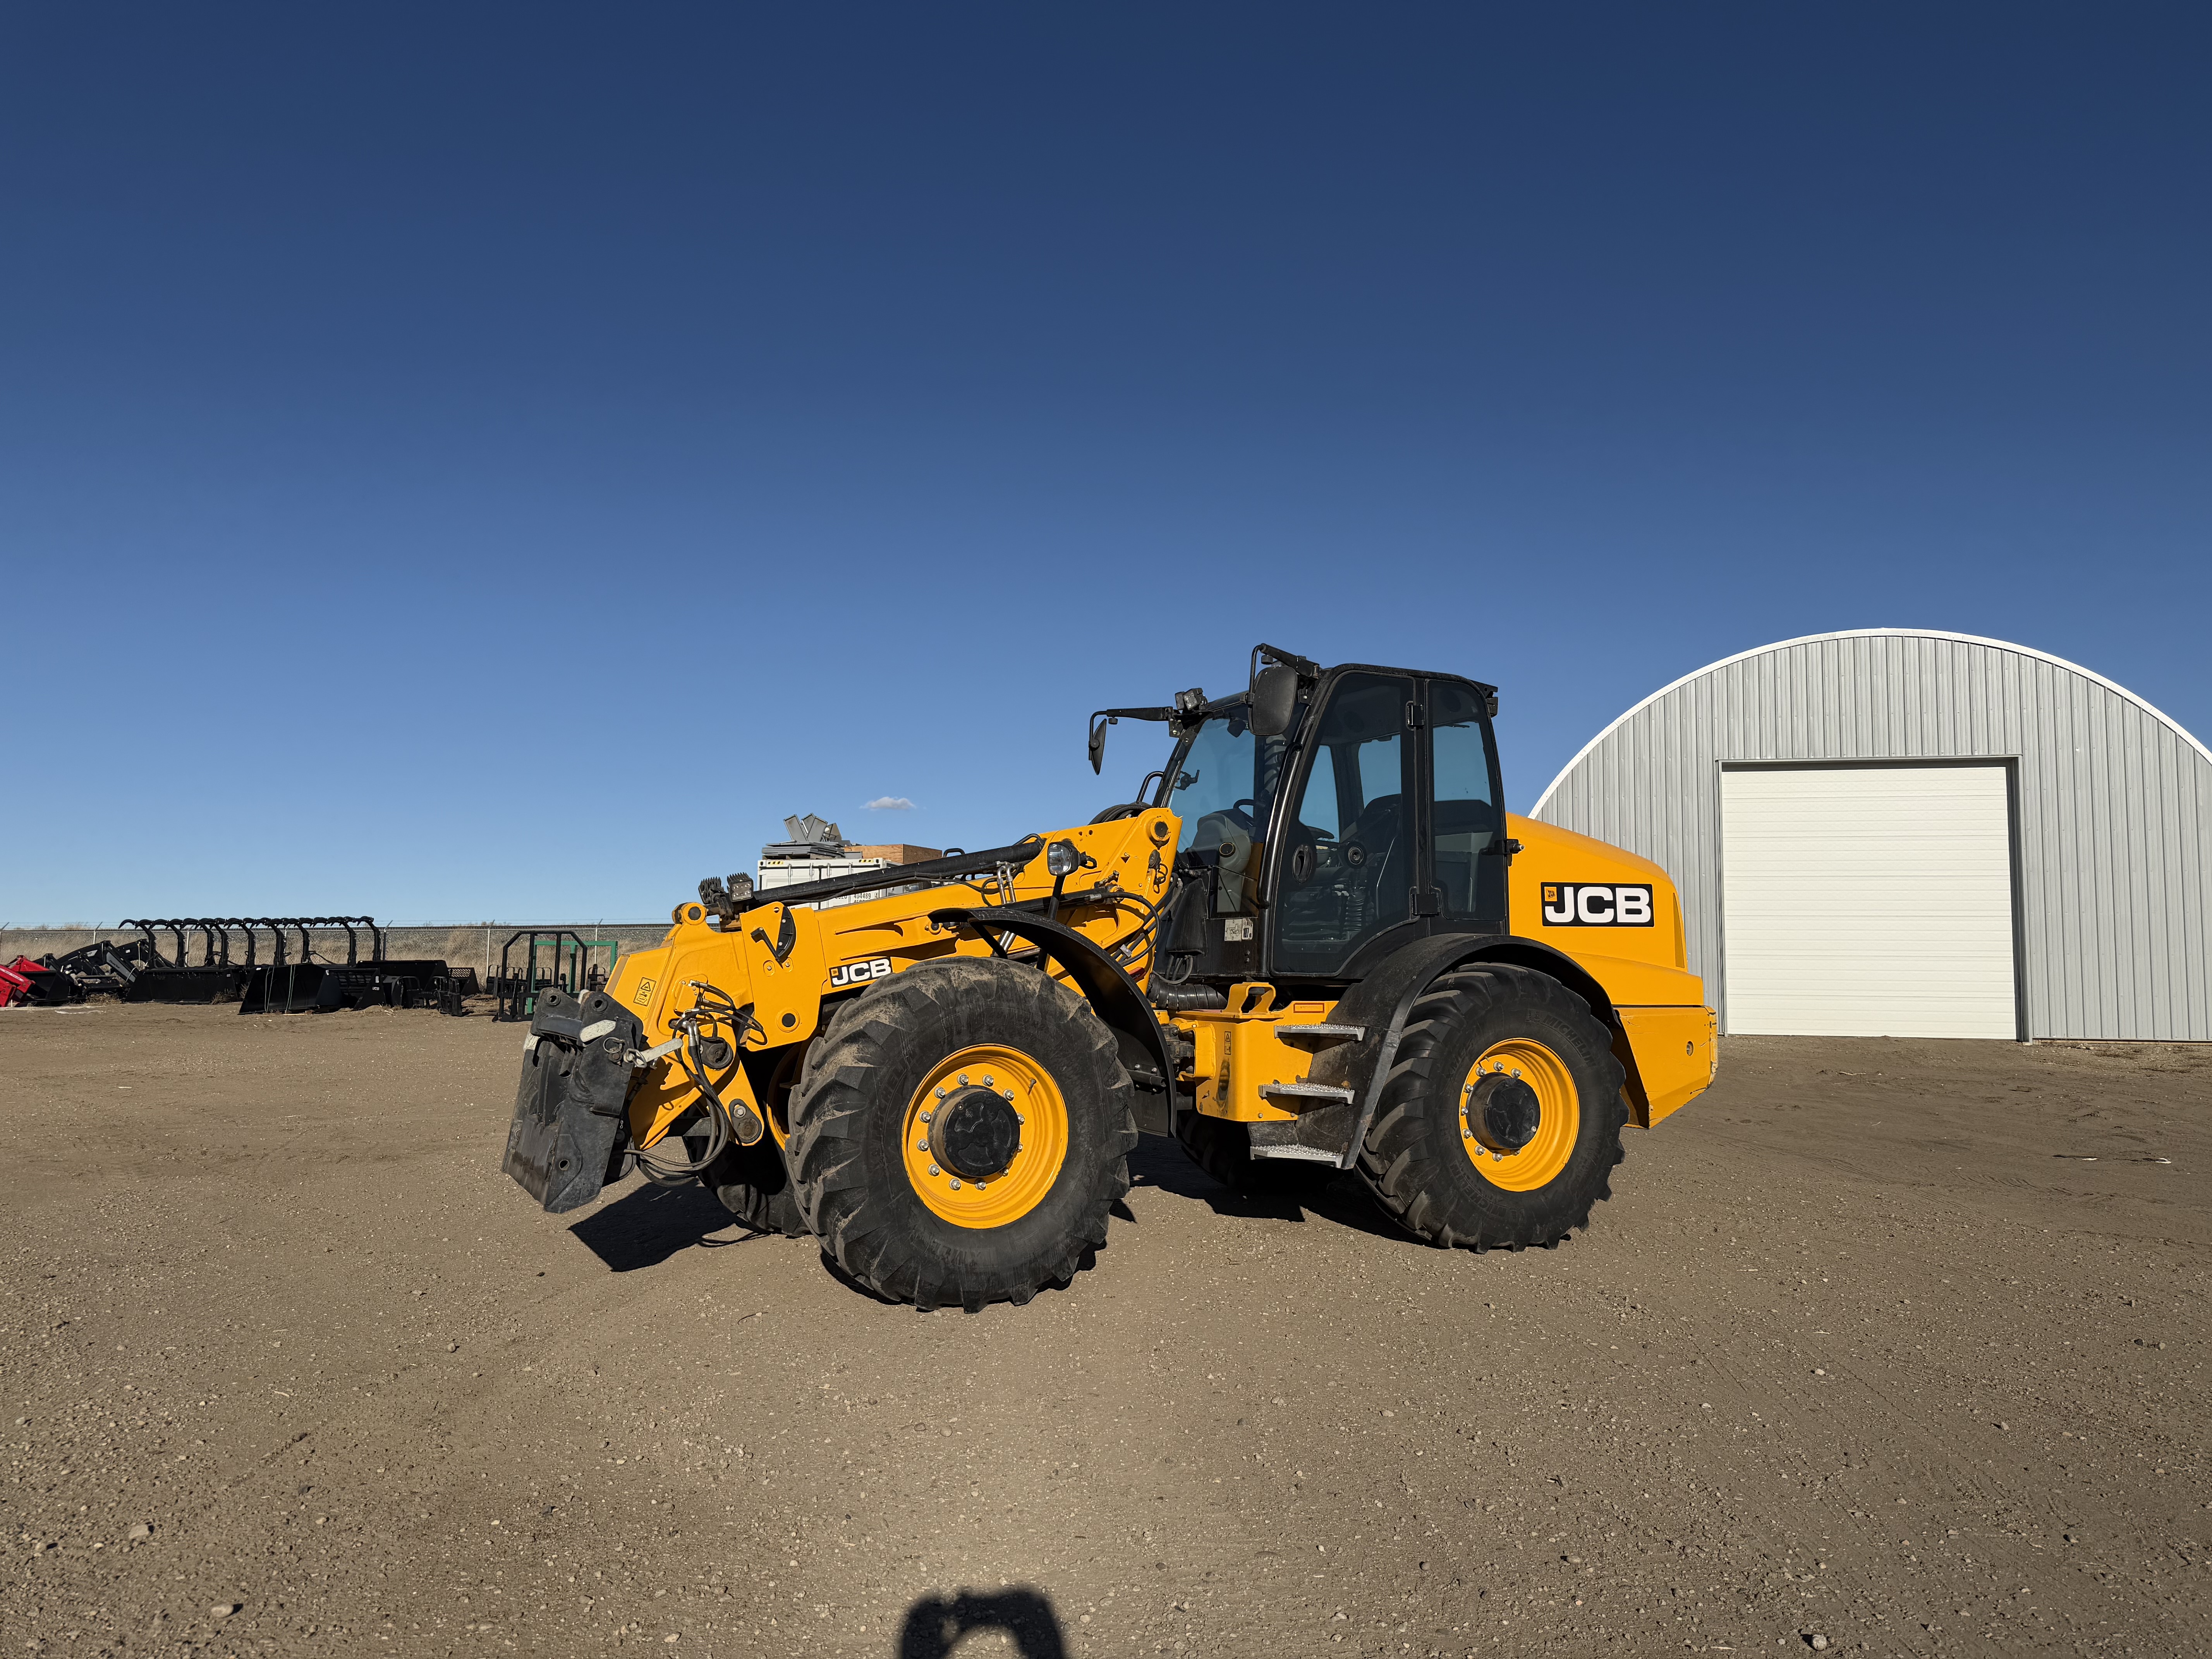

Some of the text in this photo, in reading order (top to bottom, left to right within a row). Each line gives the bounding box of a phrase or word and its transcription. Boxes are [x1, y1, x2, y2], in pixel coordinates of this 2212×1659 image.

[1545, 886, 1651, 923] JCB
[832, 958, 891, 985] JCB
[1542, 1014, 1596, 1067] MICHELIN
[1448, 1163, 1507, 1218] MICHELIN
